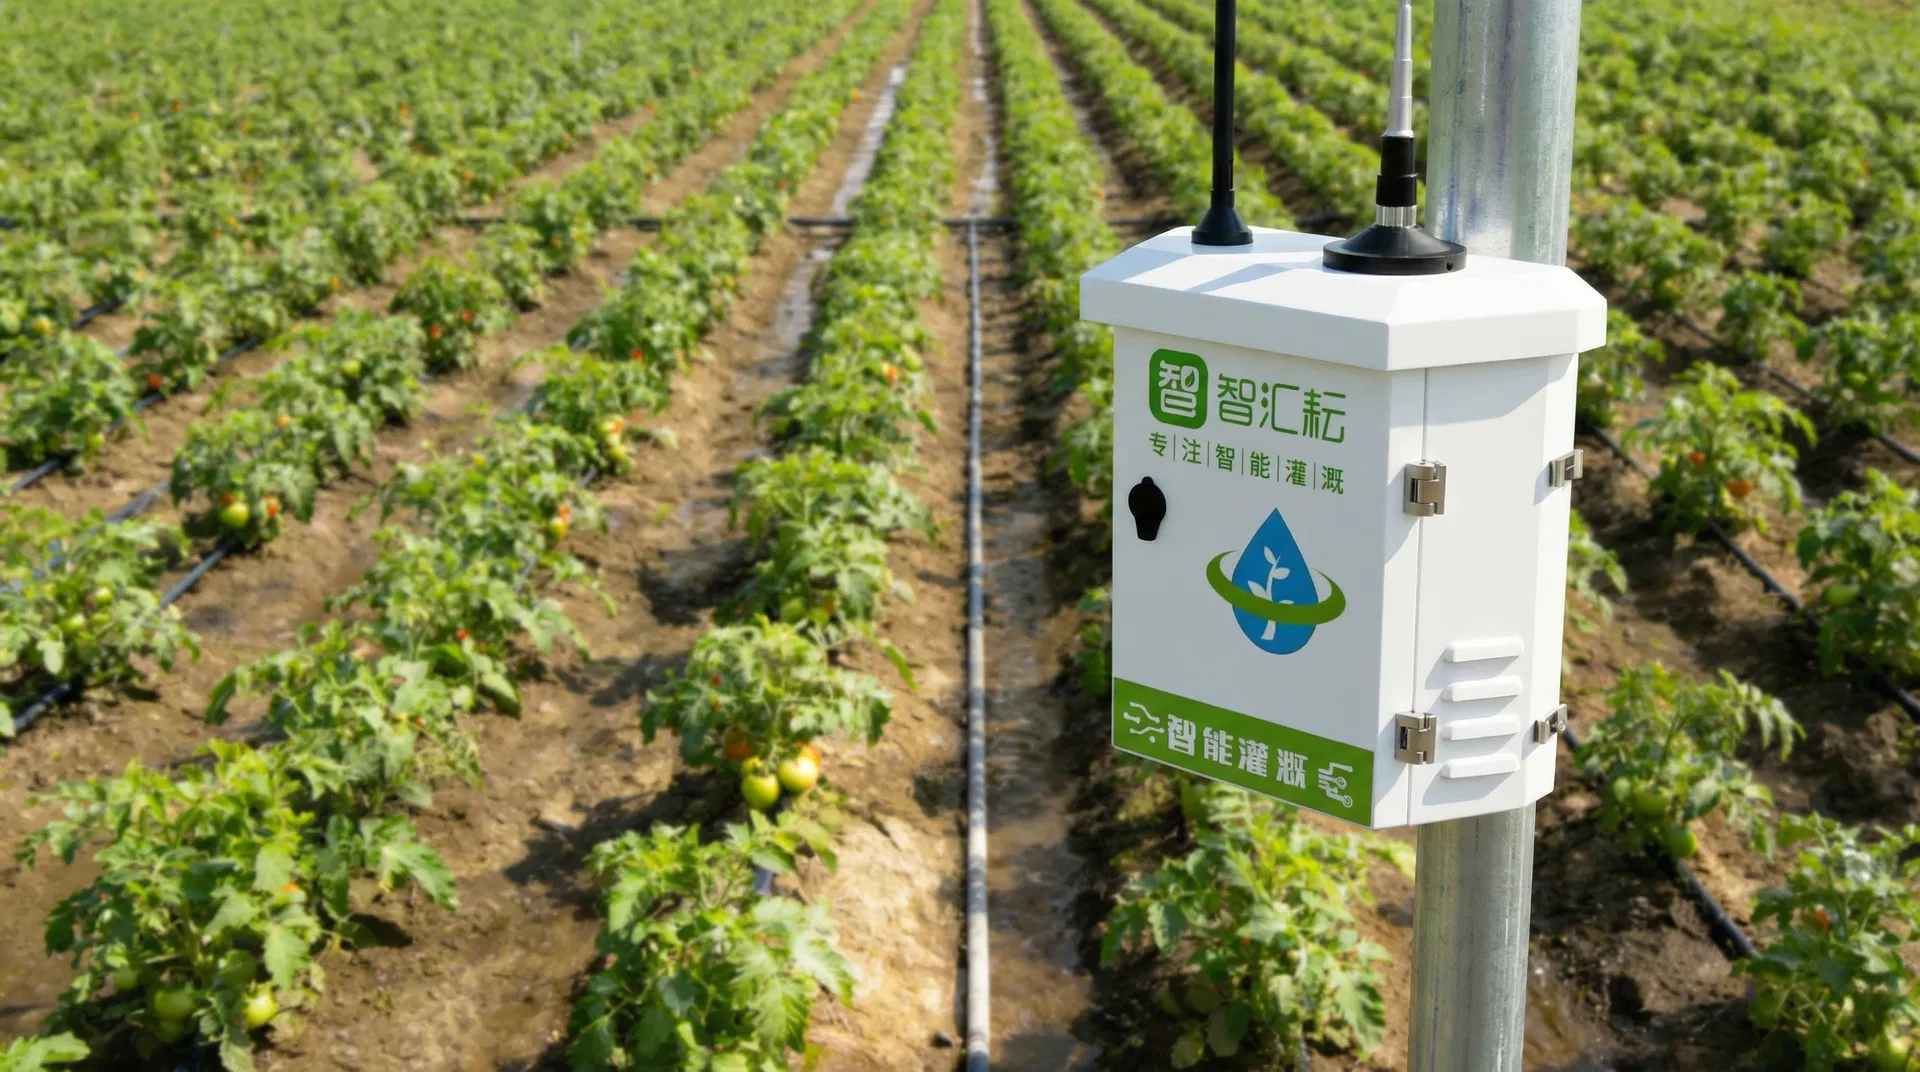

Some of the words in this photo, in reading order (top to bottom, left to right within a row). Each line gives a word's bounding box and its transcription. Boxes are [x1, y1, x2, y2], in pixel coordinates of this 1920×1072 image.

[1158, 360, 1200, 418] 智
[1217, 373, 1346, 444] 智汇耘
[1167, 713, 1309, 789] 智能灌溉
